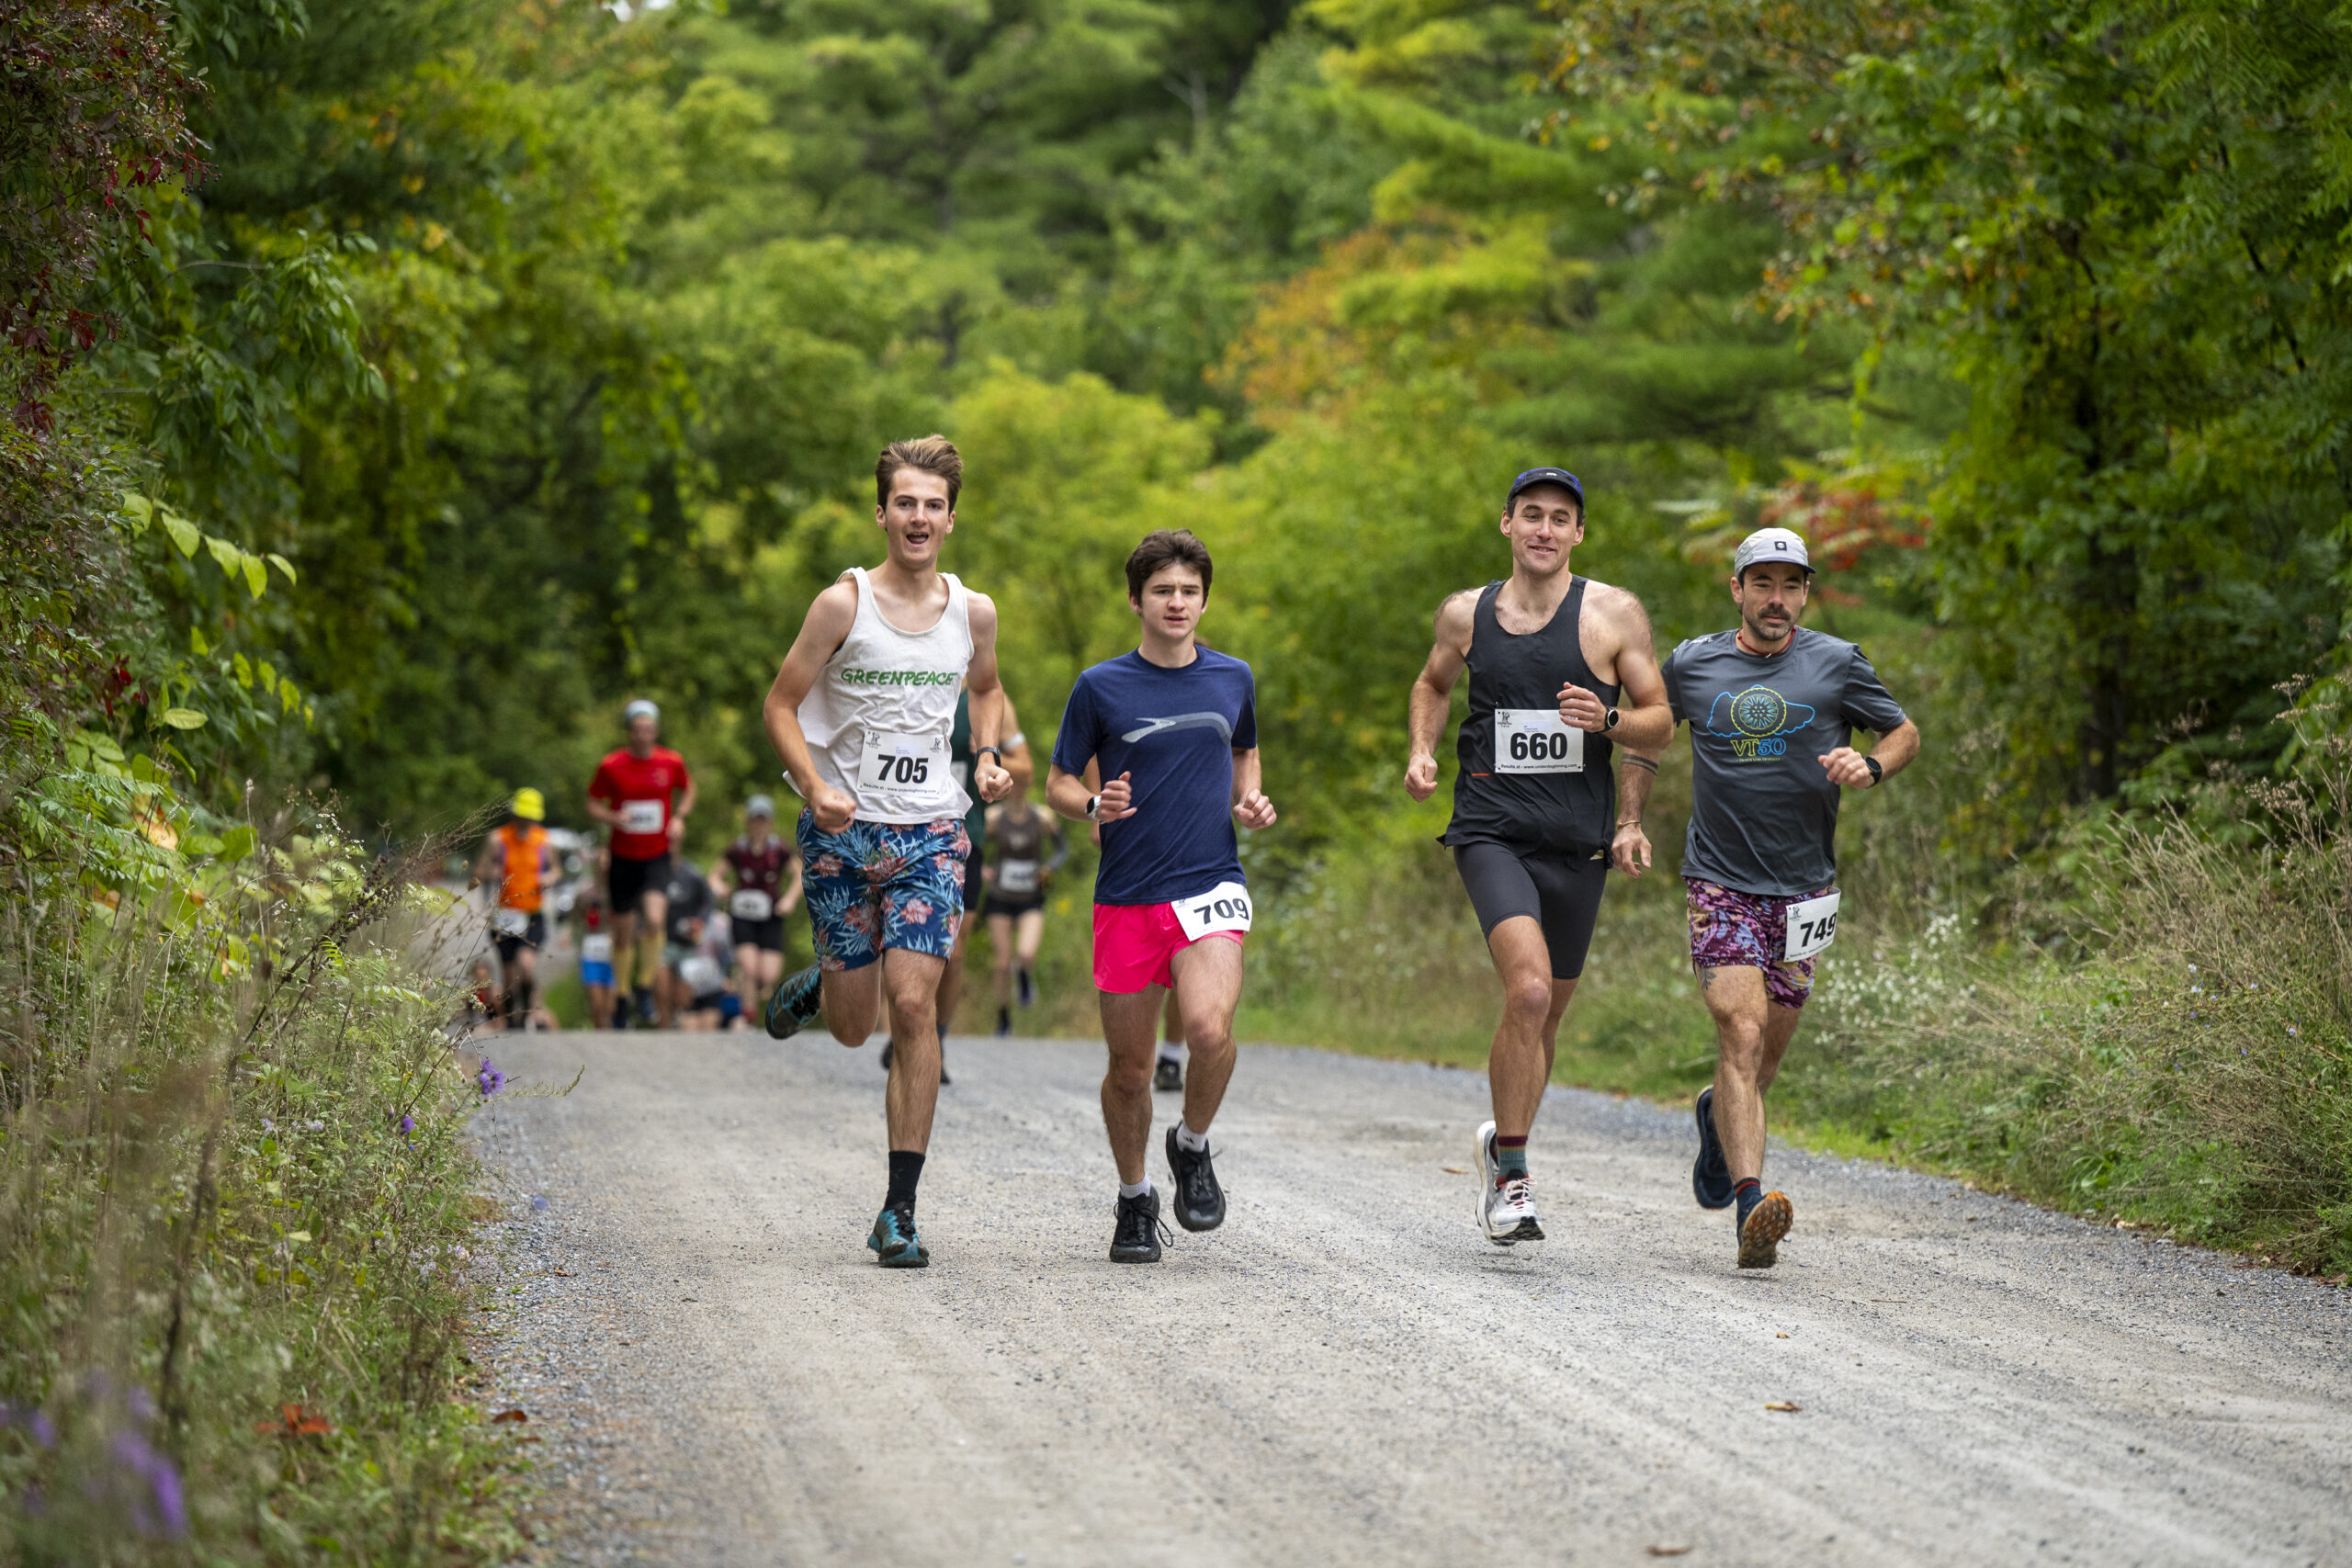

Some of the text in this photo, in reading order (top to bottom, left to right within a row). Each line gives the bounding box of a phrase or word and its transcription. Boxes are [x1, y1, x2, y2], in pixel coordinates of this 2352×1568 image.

[841, 668, 958, 686] GREENPEACE
[1510, 732, 1567, 761] 660
[1730, 738, 1787, 757] VT50
[877, 754, 929, 784] 705
[1193, 897, 1250, 925] 709
[1800, 911, 1838, 948] 749
